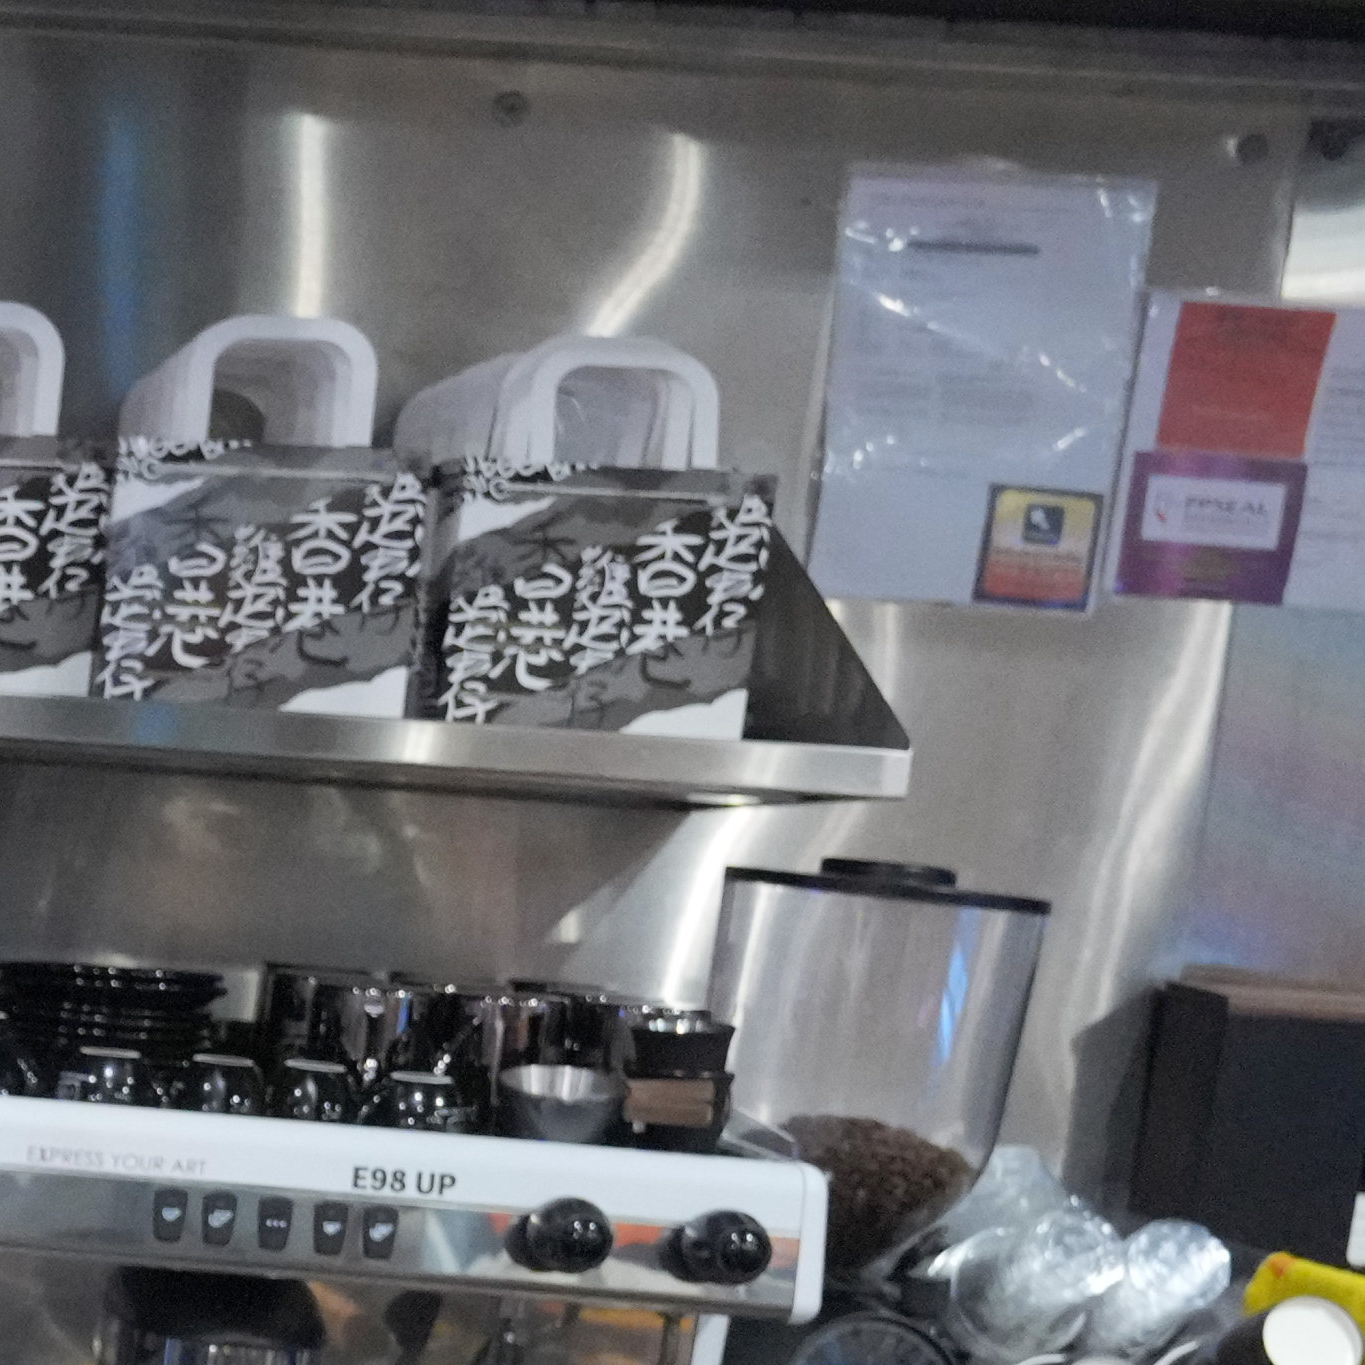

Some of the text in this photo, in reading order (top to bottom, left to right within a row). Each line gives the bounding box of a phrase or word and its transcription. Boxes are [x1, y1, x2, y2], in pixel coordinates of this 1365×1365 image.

[26, 1144, 208, 1175] EXPRESS YOUR ART
[352, 1166, 457, 1197] E98 UP
